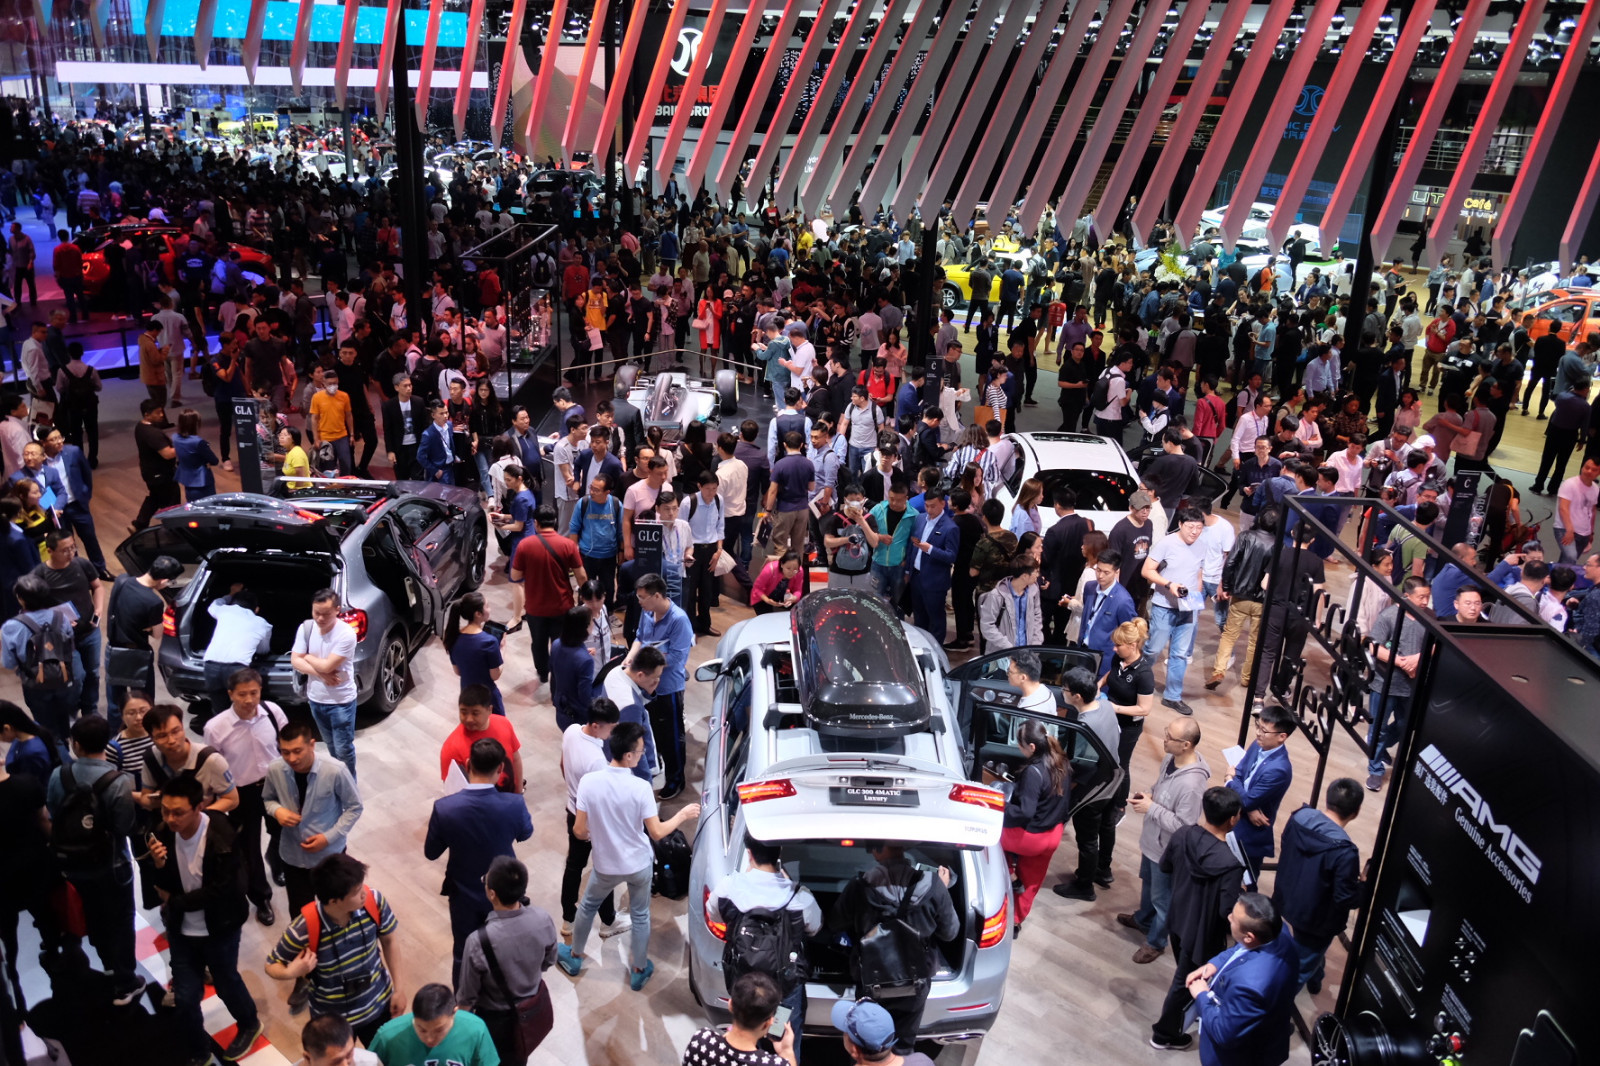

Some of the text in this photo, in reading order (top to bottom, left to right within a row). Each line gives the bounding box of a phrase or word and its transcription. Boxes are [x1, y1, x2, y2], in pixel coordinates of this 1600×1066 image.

[1463, 197, 1492, 211] Café
[235, 405, 252, 415] GLA
[638, 530, 660, 542] GLC
[849, 712, 894, 721] Mercedes-Benz
[1449, 777, 1543, 885] AMG
[1454, 806, 1533, 905] Genuine Accessories
